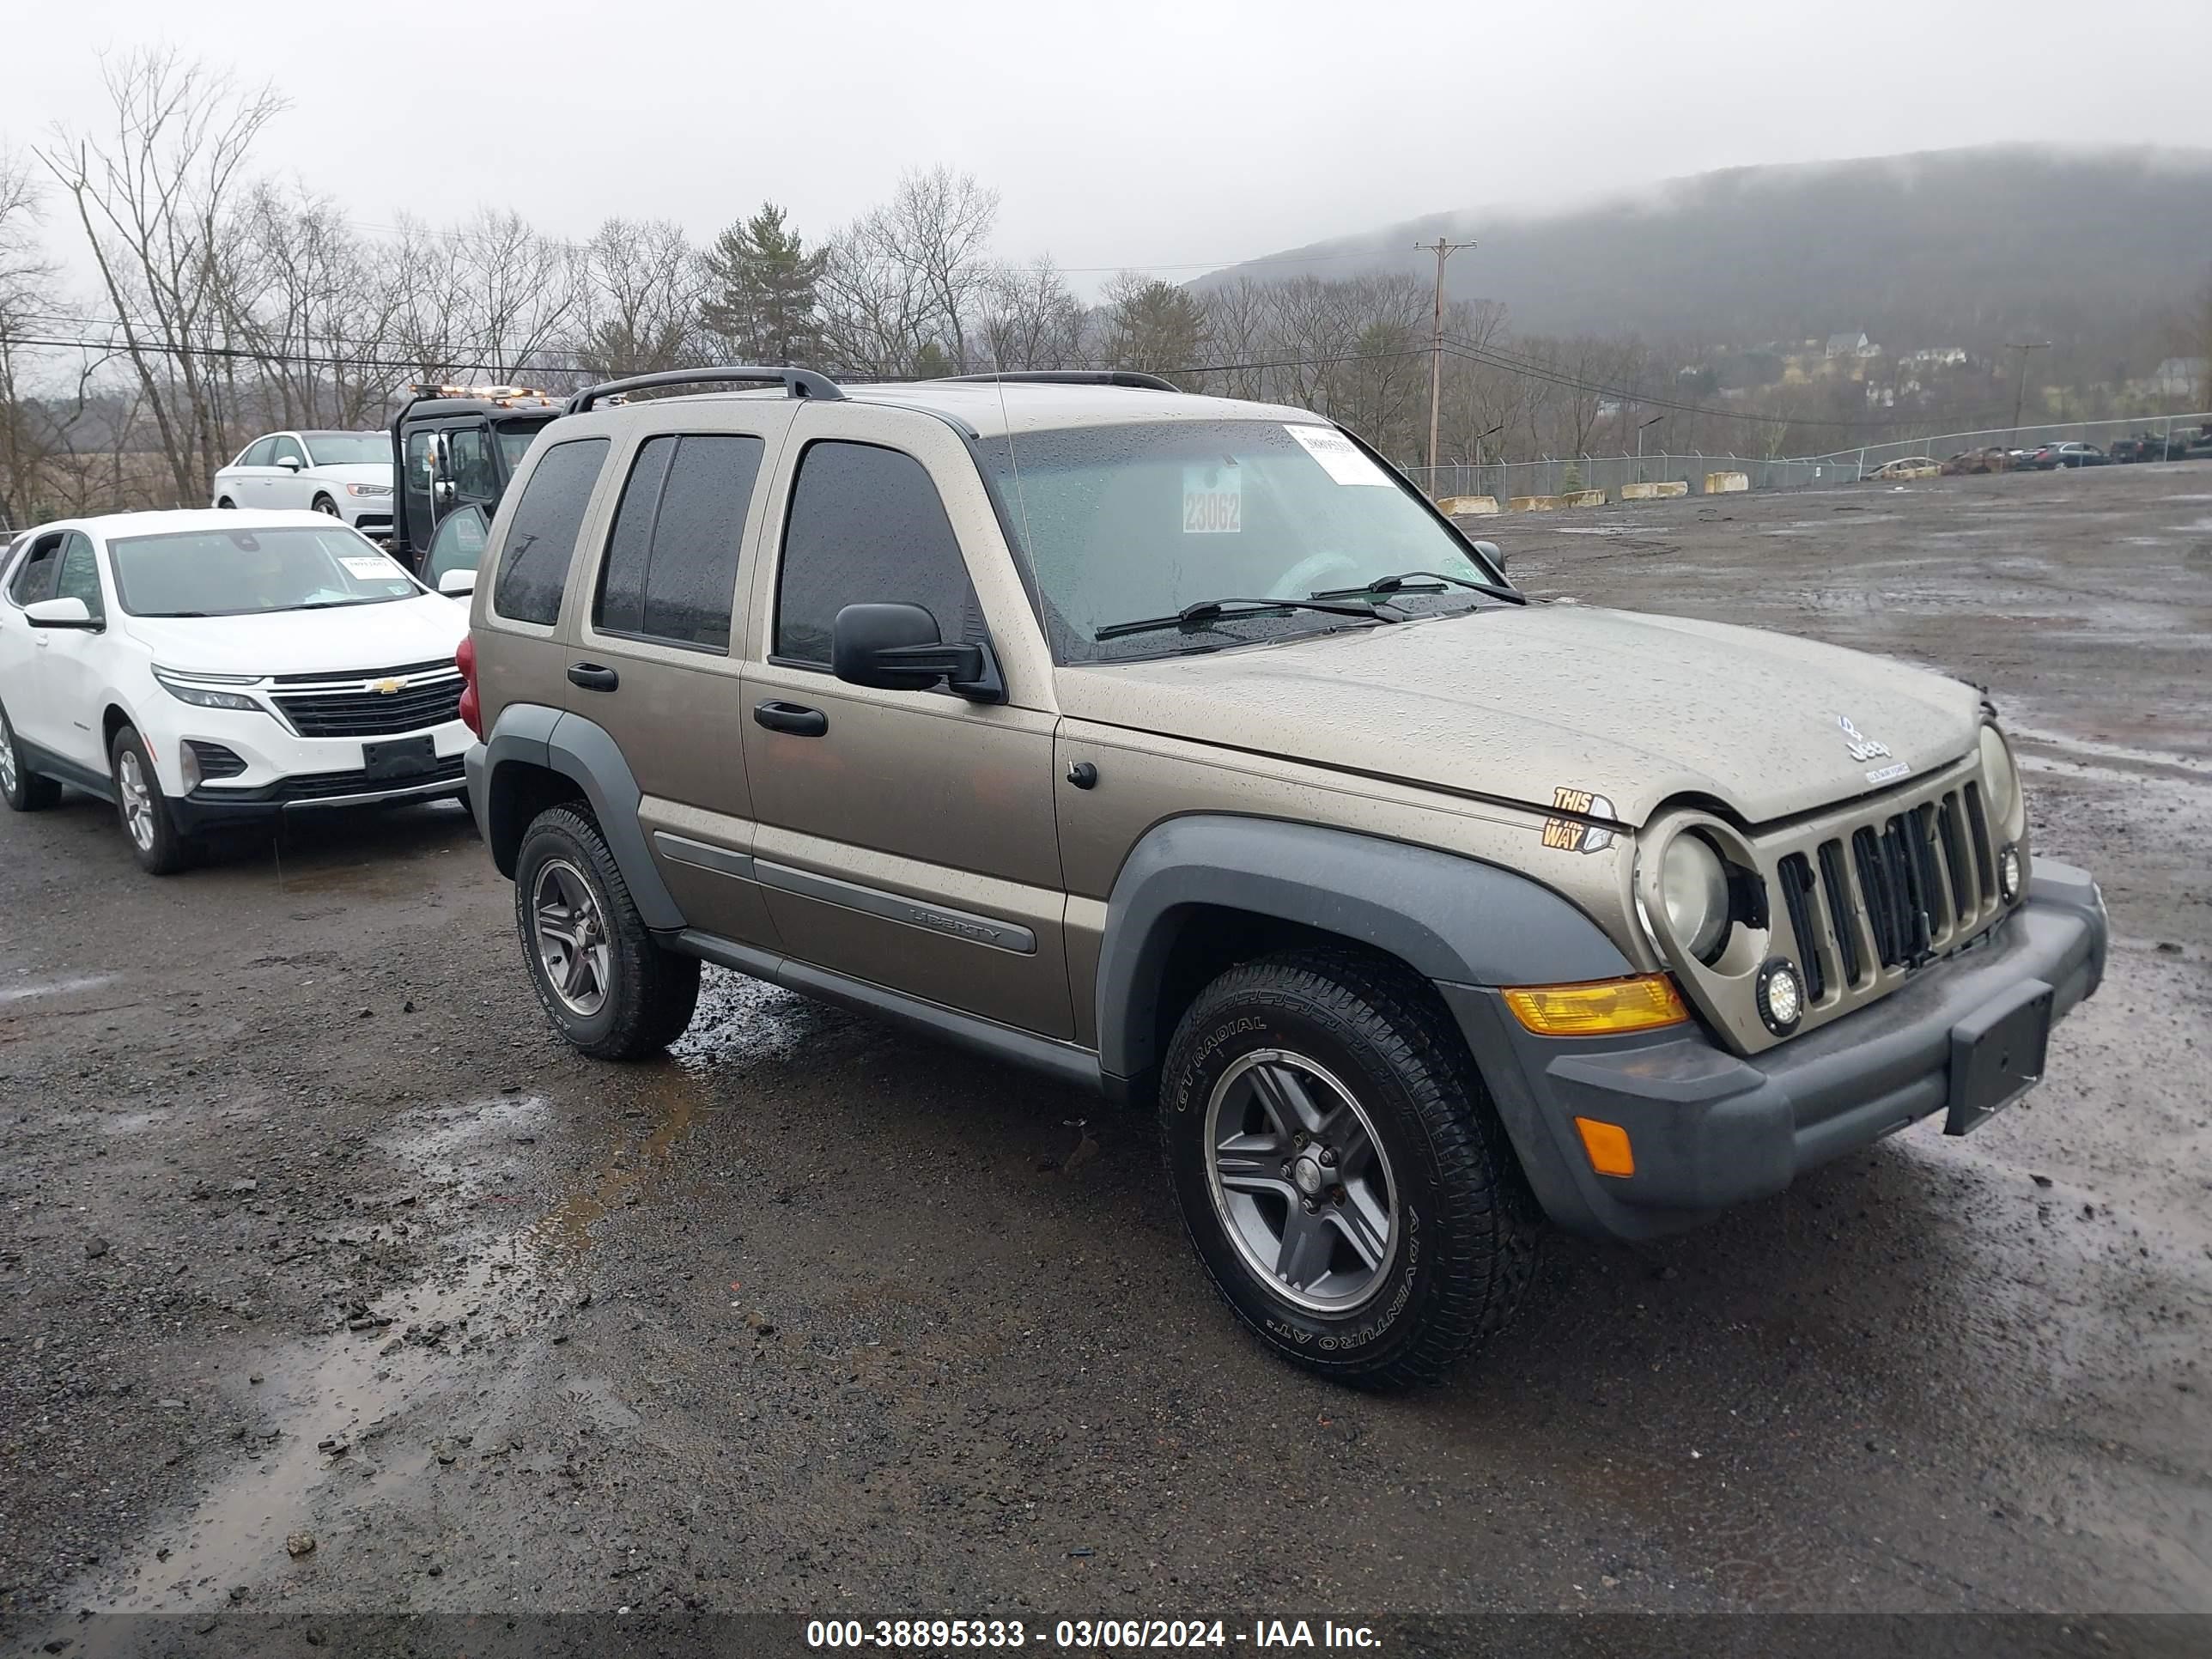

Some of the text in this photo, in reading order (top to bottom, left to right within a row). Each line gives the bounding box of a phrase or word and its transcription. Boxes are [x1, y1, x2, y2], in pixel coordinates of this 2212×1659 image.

[1186, 493, 1238, 530] 23062
[1845, 741, 1892, 763] Jeep
[1554, 787, 1593, 813] THIS
[1543, 824, 1583, 850] WAY
[909, 908, 1002, 941] LIBERTY
[1176, 1016, 1268, 1113] GT RADIAL
[1318, 1204, 1420, 1352] ADVENTURO
